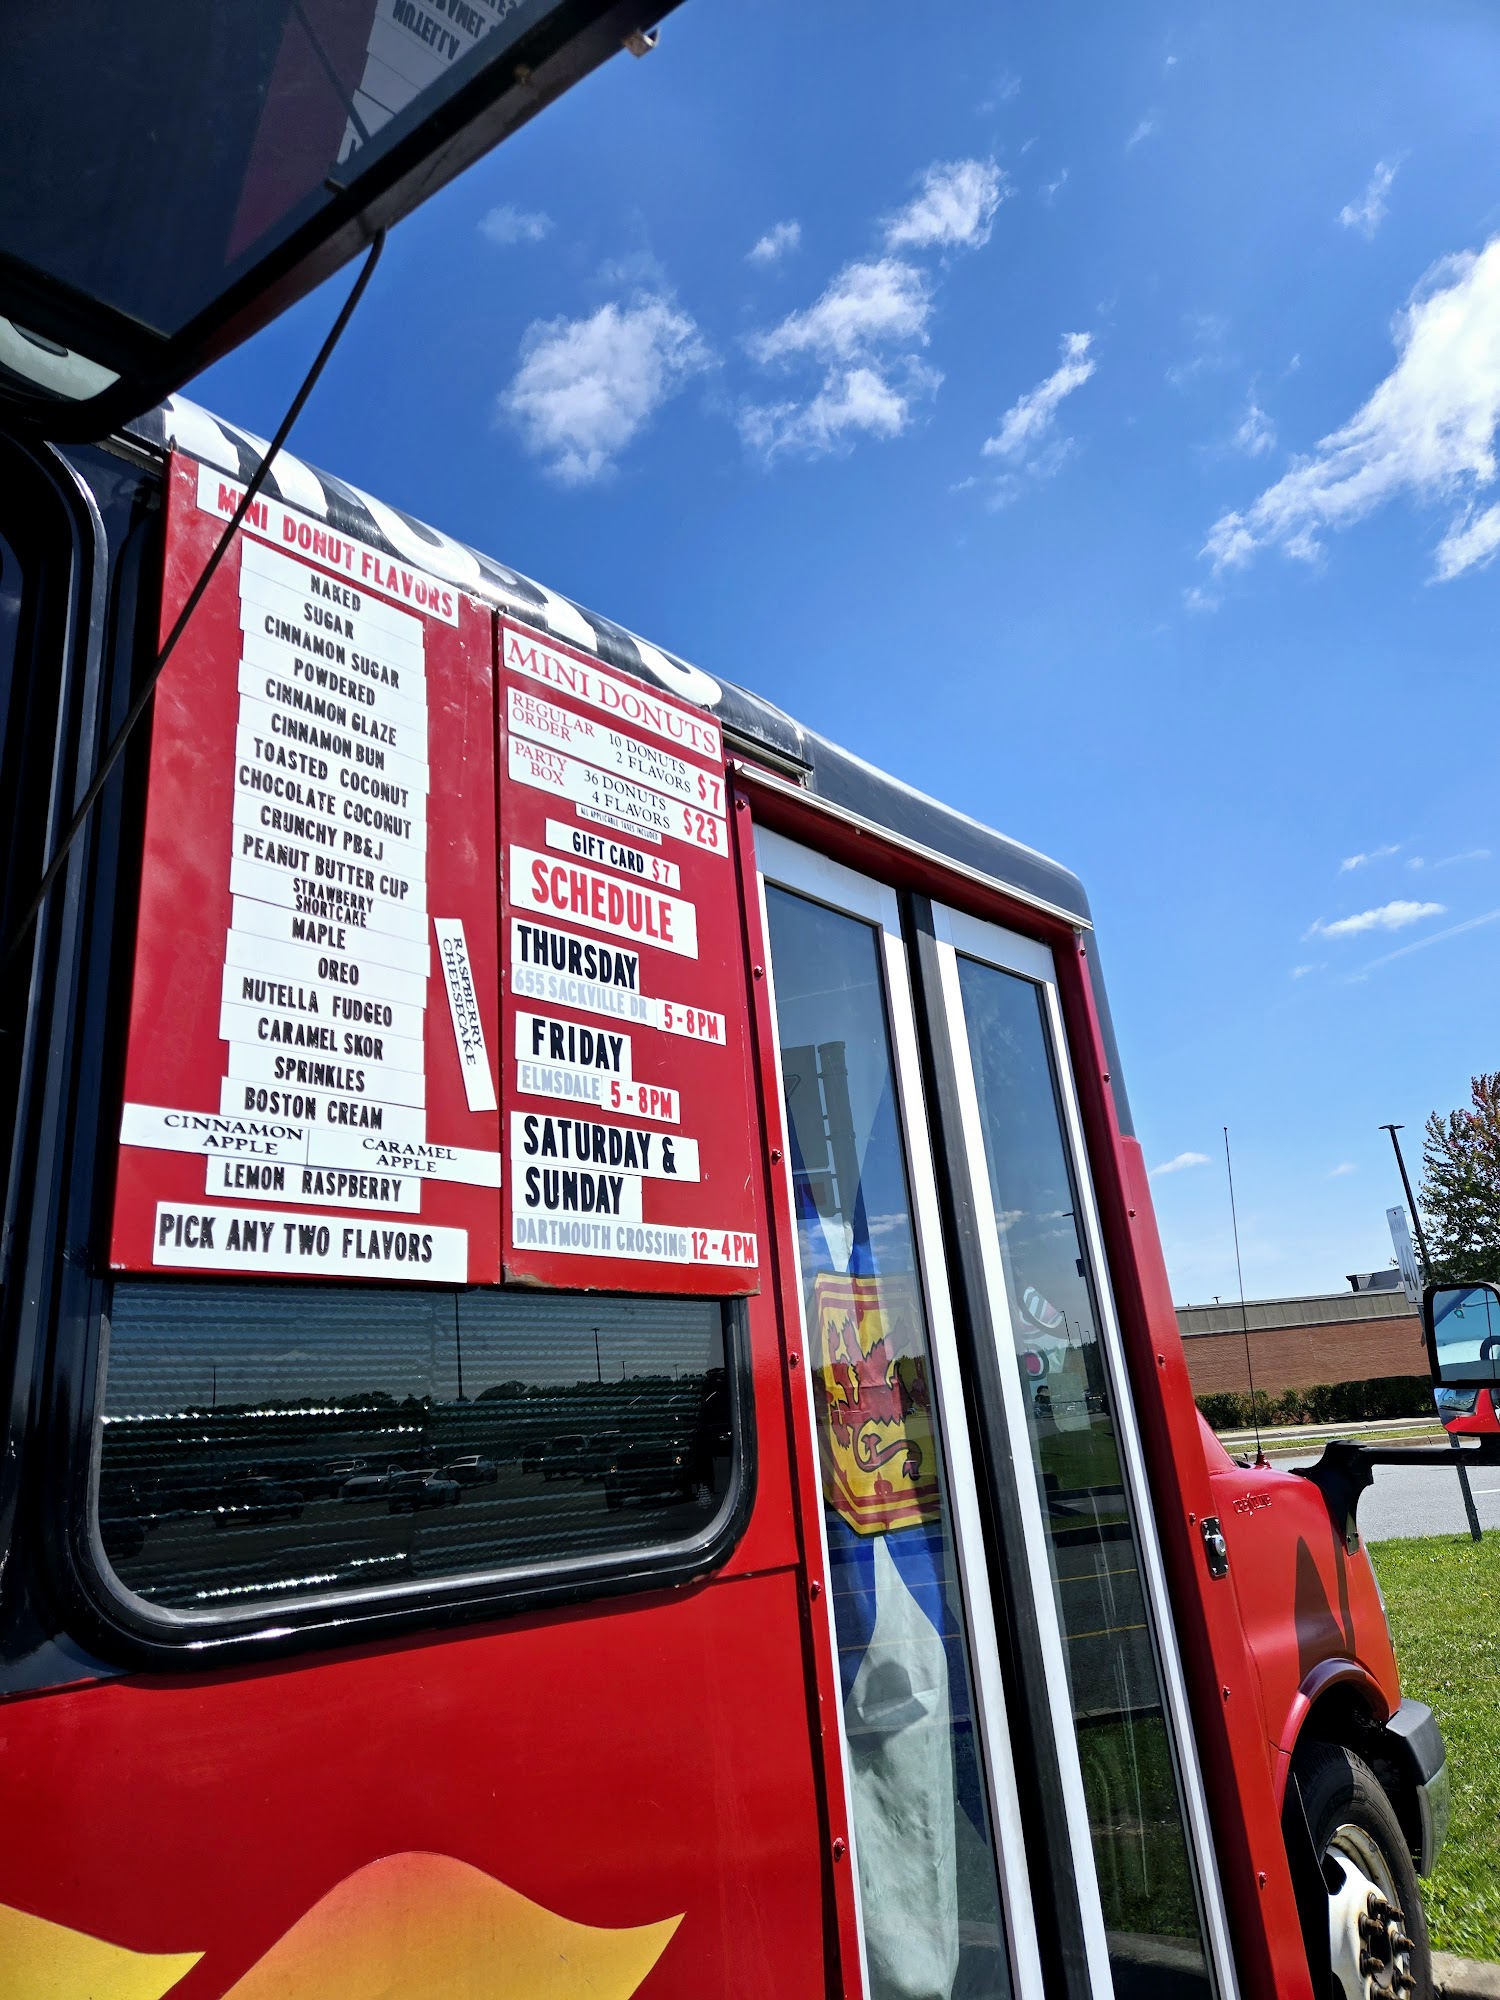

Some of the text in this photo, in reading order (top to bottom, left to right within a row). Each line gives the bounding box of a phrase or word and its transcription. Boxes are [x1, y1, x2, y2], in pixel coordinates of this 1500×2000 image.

[283, 515, 355, 570] DONUT
[361, 552, 453, 617] FLAVORS
[310, 574, 361, 612] NAKED
[304, 603, 354, 640] SUGAR
[264, 615, 399, 689] CINNAMON SUGAR
[293, 658, 375, 706] POWDERED
[507, 638, 716, 754] MINI DONUTS
[265, 679, 397, 746] CINNAMON GLAZE
[512, 692, 595, 737] REGULAR
[512, 708, 571, 742] ORDER
[271, 714, 384, 770] CINNAMON BUN
[514, 741, 568, 772] PARTY
[609, 732, 685, 774] 10 DONUTS
[254, 737, 409, 808] TOASTED COCONUT
[531, 762, 564, 786] BOX
[584, 770, 666, 810] 36 DONUTS
[616, 752, 719, 809] 2 FLAVORS $7
[239, 765, 411, 839] CHOCOLATE COCONUT
[592, 792, 718, 848] 4 FLAVORS $23
[260, 805, 384, 861] CRUNCHY PB&J
[590, 810, 618, 827] APPLICABLE
[636, 827, 658, 841] INCLUDED
[243, 834, 409, 900] PEANUT BUTTER CUP
[573, 831, 670, 884] GIFT CARD $7
[293, 877, 374, 913] STRAWBERRY
[295, 895, 366, 928] SHORTCAKE
[531, 858, 674, 943] SCHEDULE
[292, 917, 346, 950] MAPLE
[317, 958, 359, 986] OREO
[517, 925, 637, 990] THURSDAY
[242, 977, 392, 1027] NUTELLA FUDGEO
[443, 938, 476, 1065] CHEESECAKE
[453, 937, 483, 1049] RASPBERRY
[515, 969, 545, 996] 655
[548, 976, 625, 1014] SACKVILLE
[630, 999, 647, 1020] DR
[257, 1018, 384, 1061] CARAMEL SKOR
[532, 1018, 623, 1072] FRIDAY
[274, 1056, 365, 1093] SPRINKLES
[522, 1065, 600, 1100] ELMSDALE
[163, 1114, 304, 1140] CINNAMON
[244, 1087, 382, 1130] BOSTON CREAM
[202, 1134, 278, 1156] APPLE
[362, 1138, 457, 1161] CARAMEL
[376, 1153, 437, 1173] APPLE
[523, 1115, 677, 1174] SATURDAY &
[224, 1163, 402, 1202] LEMON RASPBERRY
[525, 1166, 624, 1215] SUNDAY
[159, 1213, 432, 1263] PICK ANY TWO FLAVORS
[516, 1217, 611, 1251] DARTMOUTH
[616, 1227, 687, 1258] CROSSING
[1400, 1245, 1418, 1291] 40
